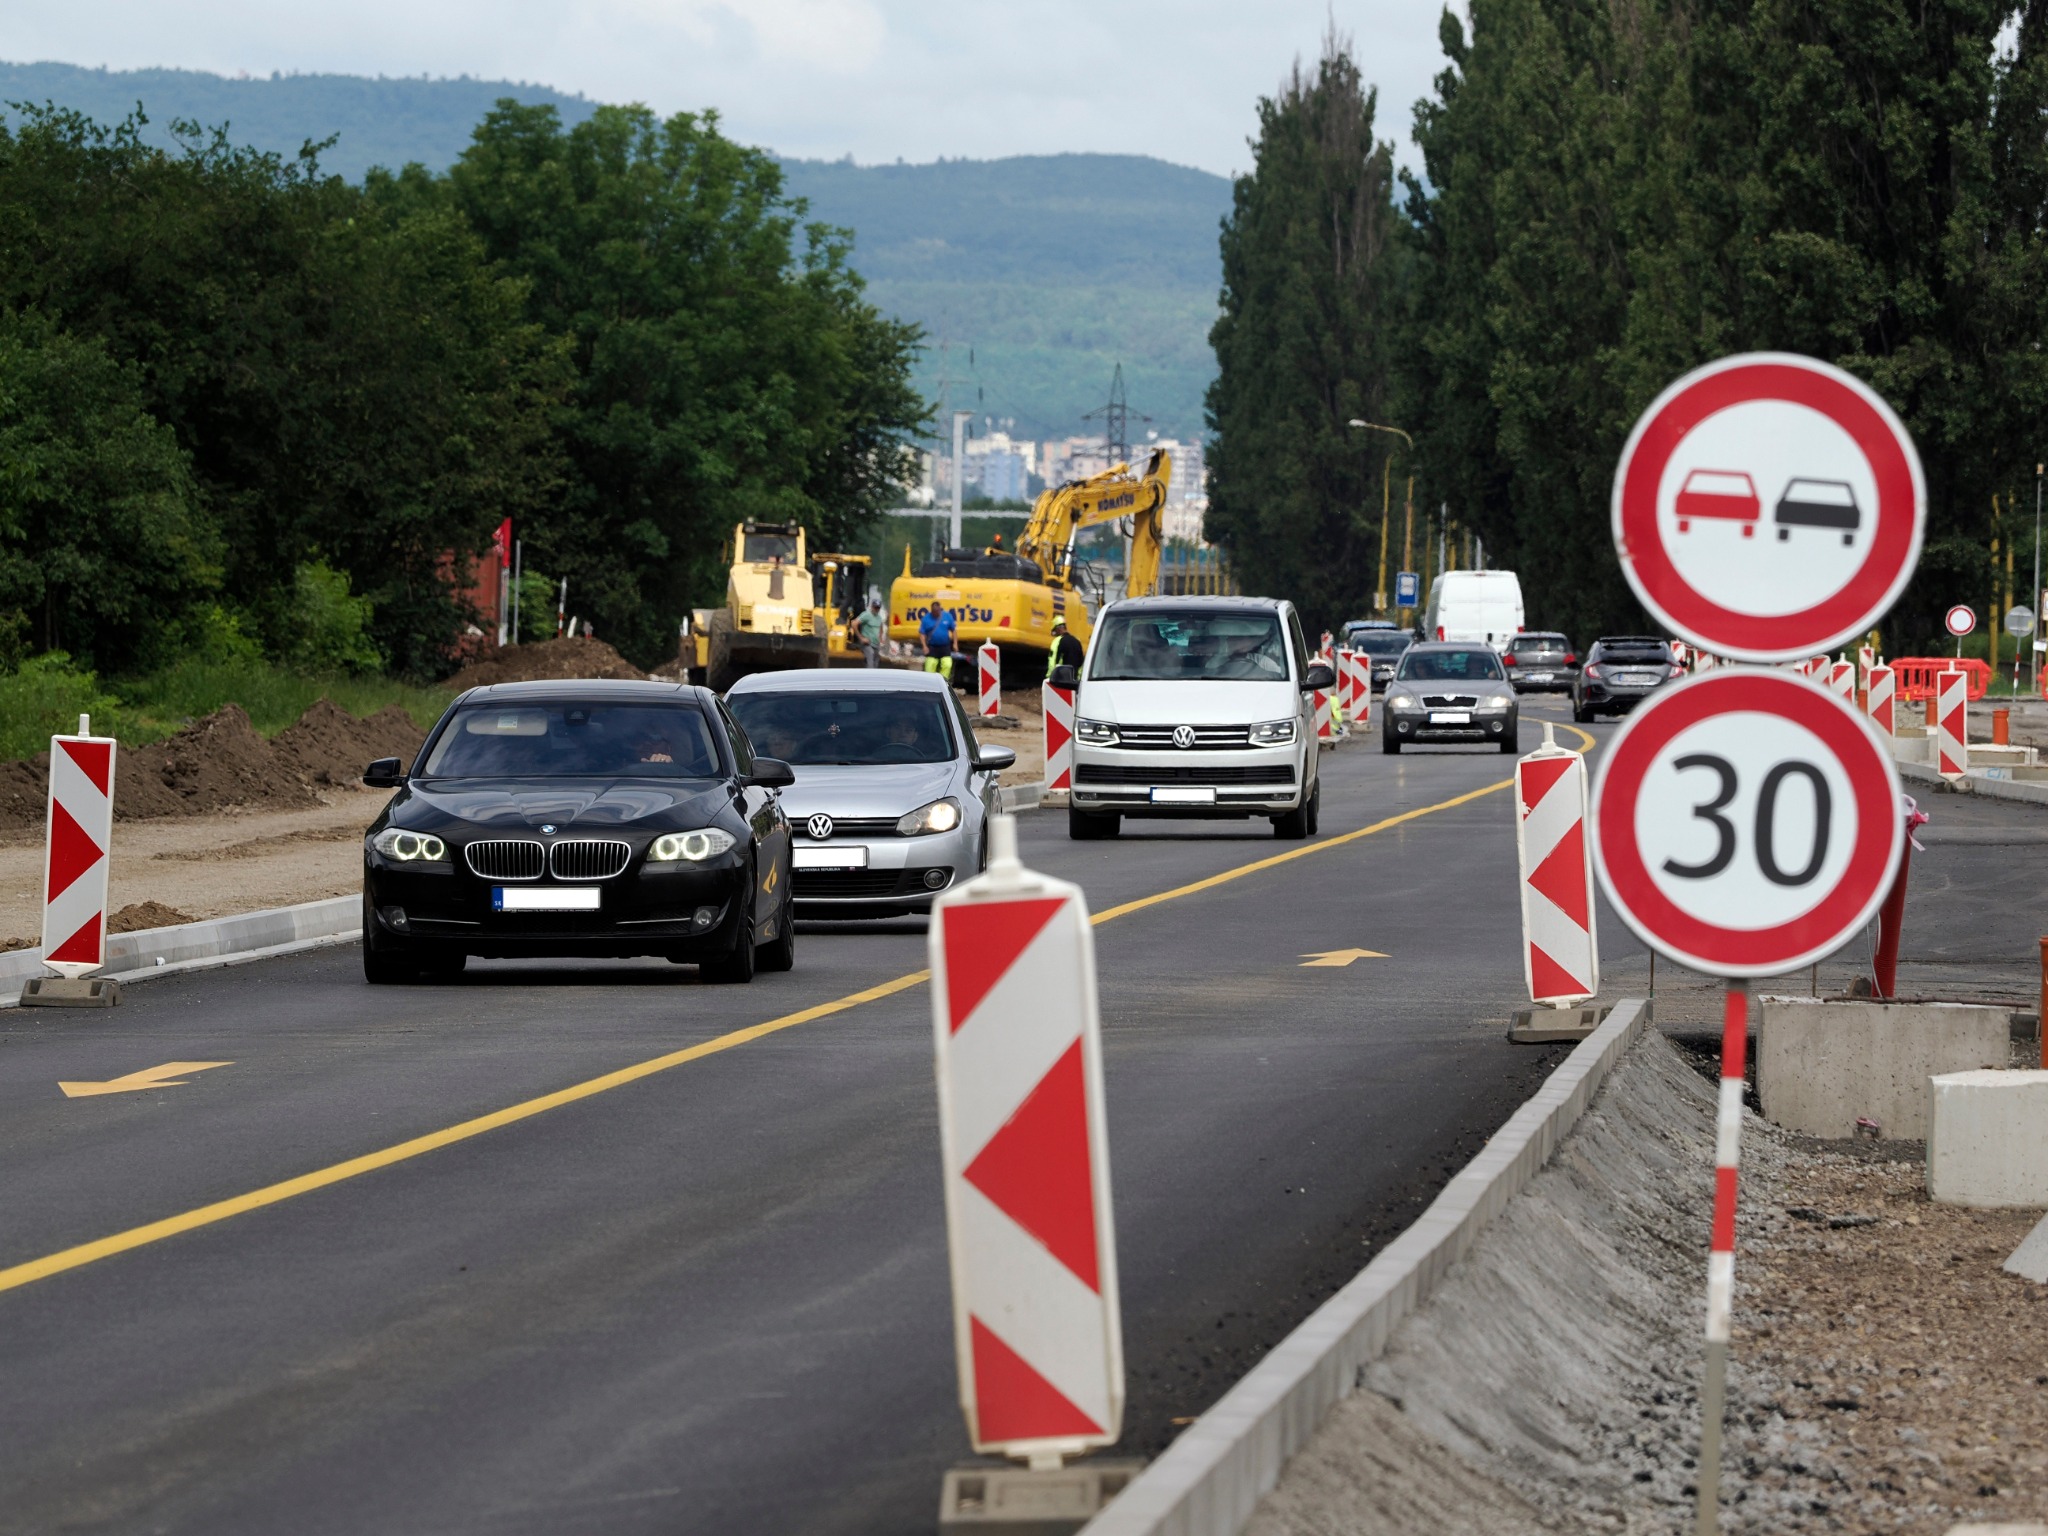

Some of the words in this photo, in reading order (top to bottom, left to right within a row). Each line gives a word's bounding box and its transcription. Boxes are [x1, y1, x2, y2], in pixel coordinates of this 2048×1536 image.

[1097, 493, 1135, 512] KOMATSU
[906, 604, 993, 622] KOATSU
[808, 814, 833, 838] VW
[1662, 754, 1832, 887] 30
